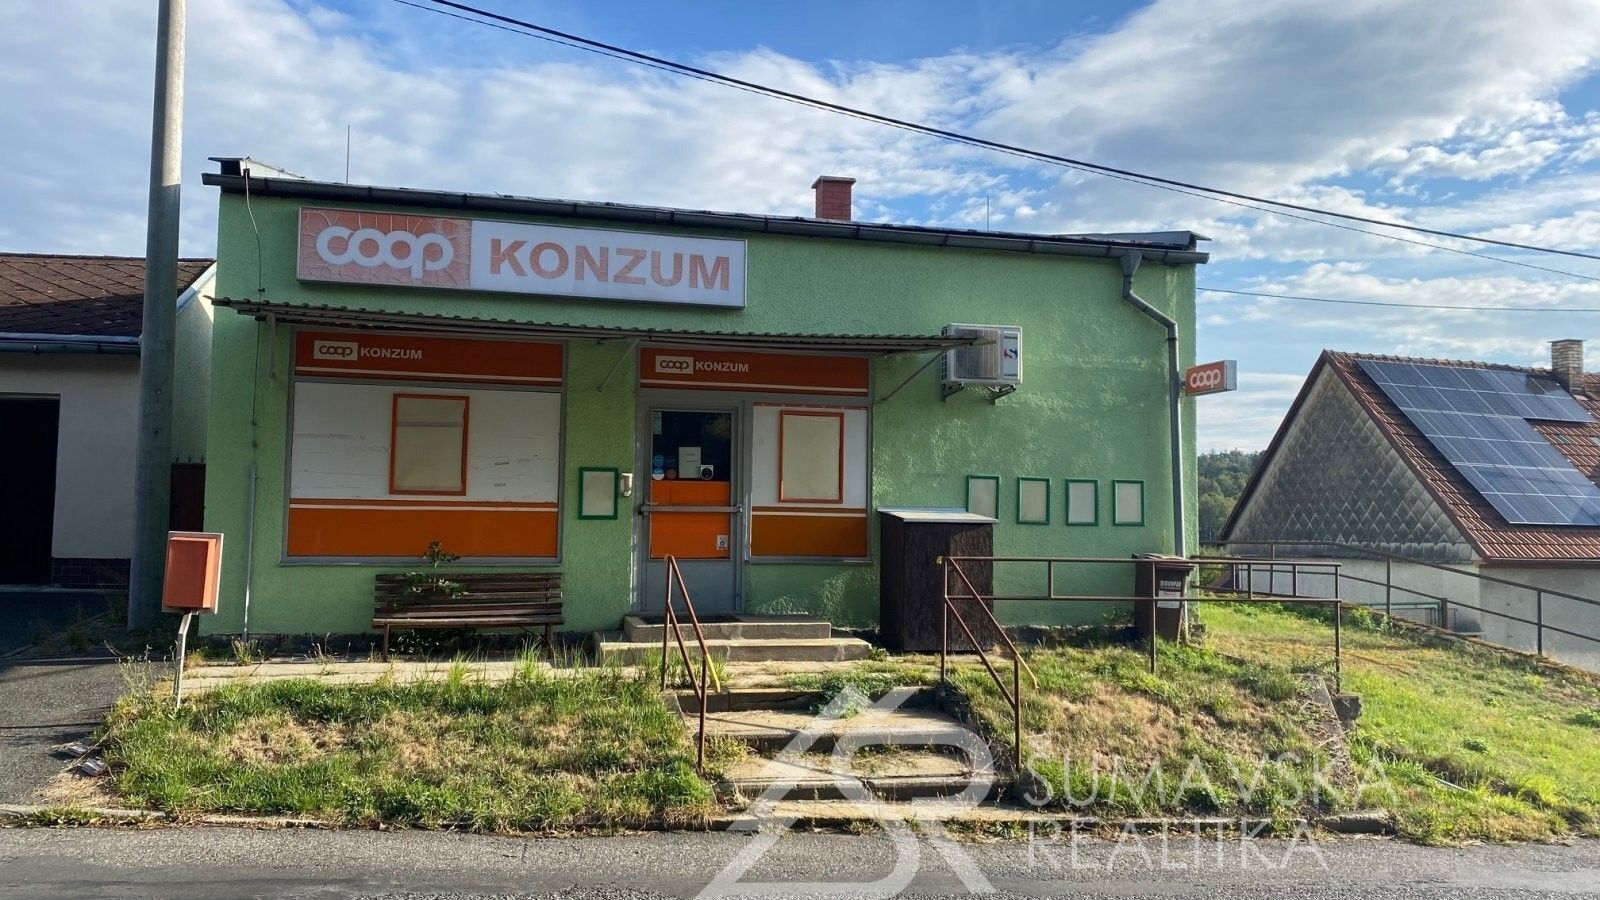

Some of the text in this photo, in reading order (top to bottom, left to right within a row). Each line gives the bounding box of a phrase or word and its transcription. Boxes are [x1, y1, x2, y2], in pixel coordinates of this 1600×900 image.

[315, 225, 730, 291] coop KONZUM
[318, 345, 423, 360] coop KONZUM
[659, 359, 749, 373] coop KONZUM
[1190, 368, 1221, 389] coop
